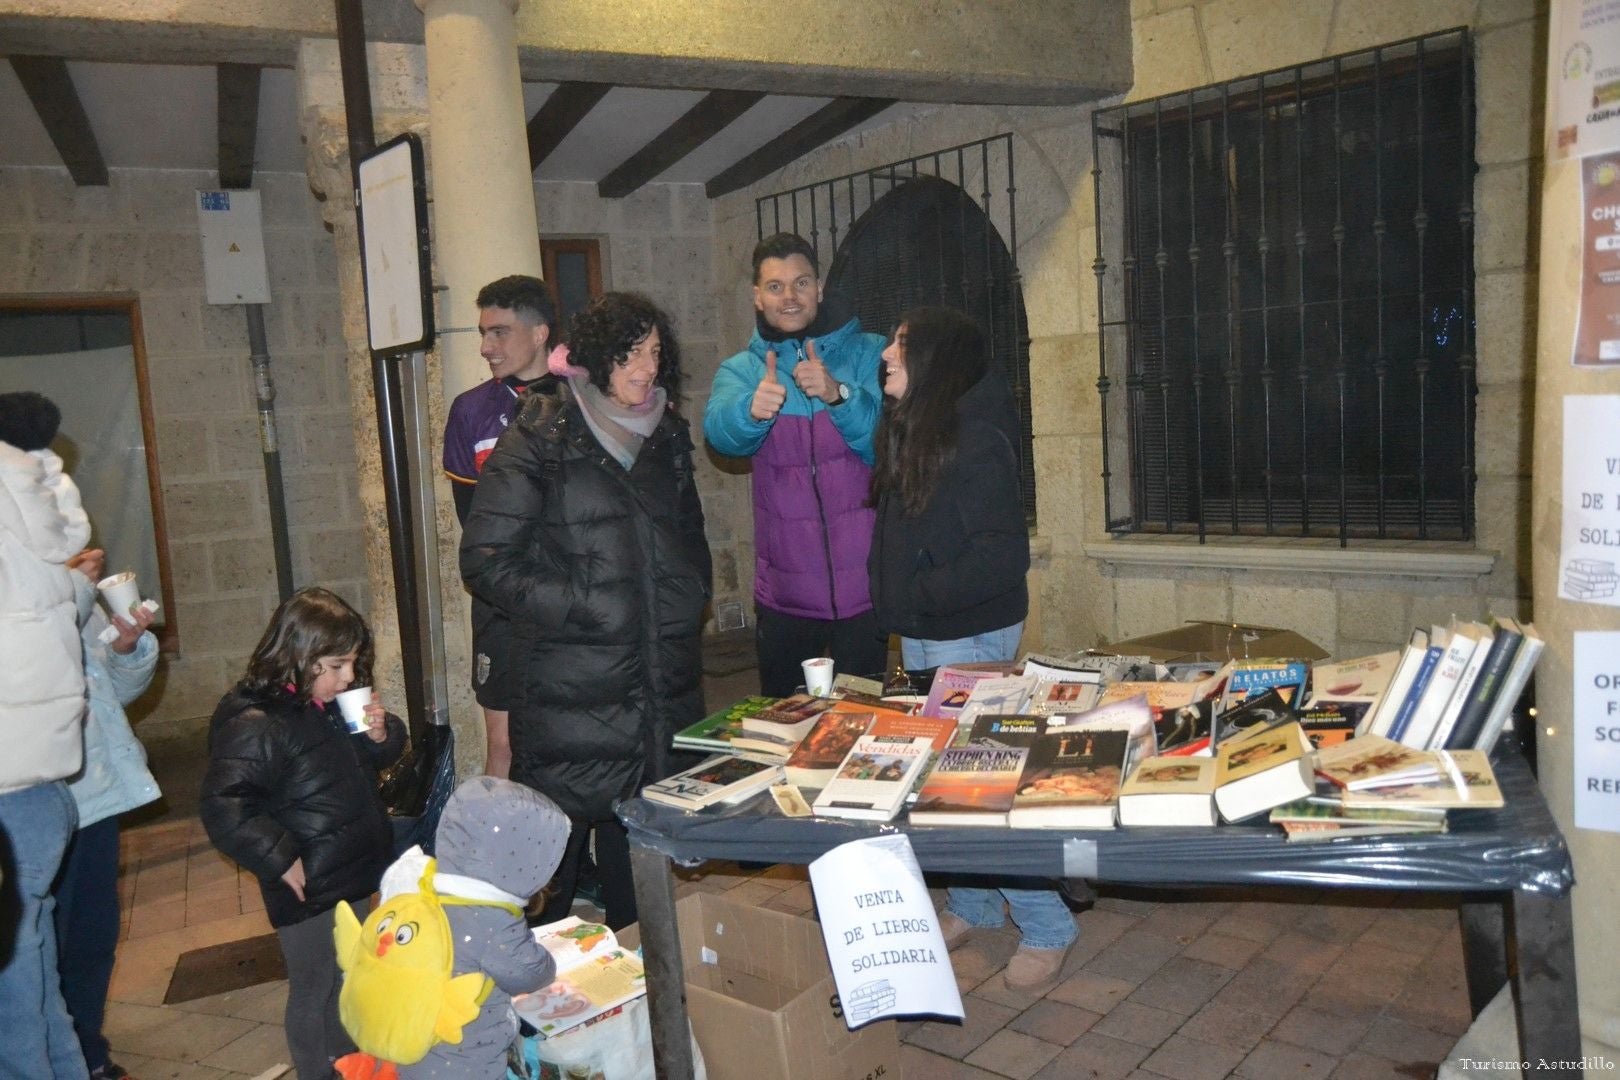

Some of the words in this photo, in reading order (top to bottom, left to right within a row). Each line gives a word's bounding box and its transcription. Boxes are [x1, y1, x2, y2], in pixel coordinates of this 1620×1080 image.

[1605, 458, 1620, 475] V
[1581, 492, 1603, 510] DE
[1234, 668, 1297, 684] RELATOS
[991, 722, 1000, 733] B
[859, 743, 922, 755] Vendidas
[944, 750, 994, 761] STEPHEN
[994, 750, 1022, 760] KING
[854, 889, 904, 909] VENTA
[844, 926, 864, 945] DE
[851, 949, 937, 973] SOLIDARIA
